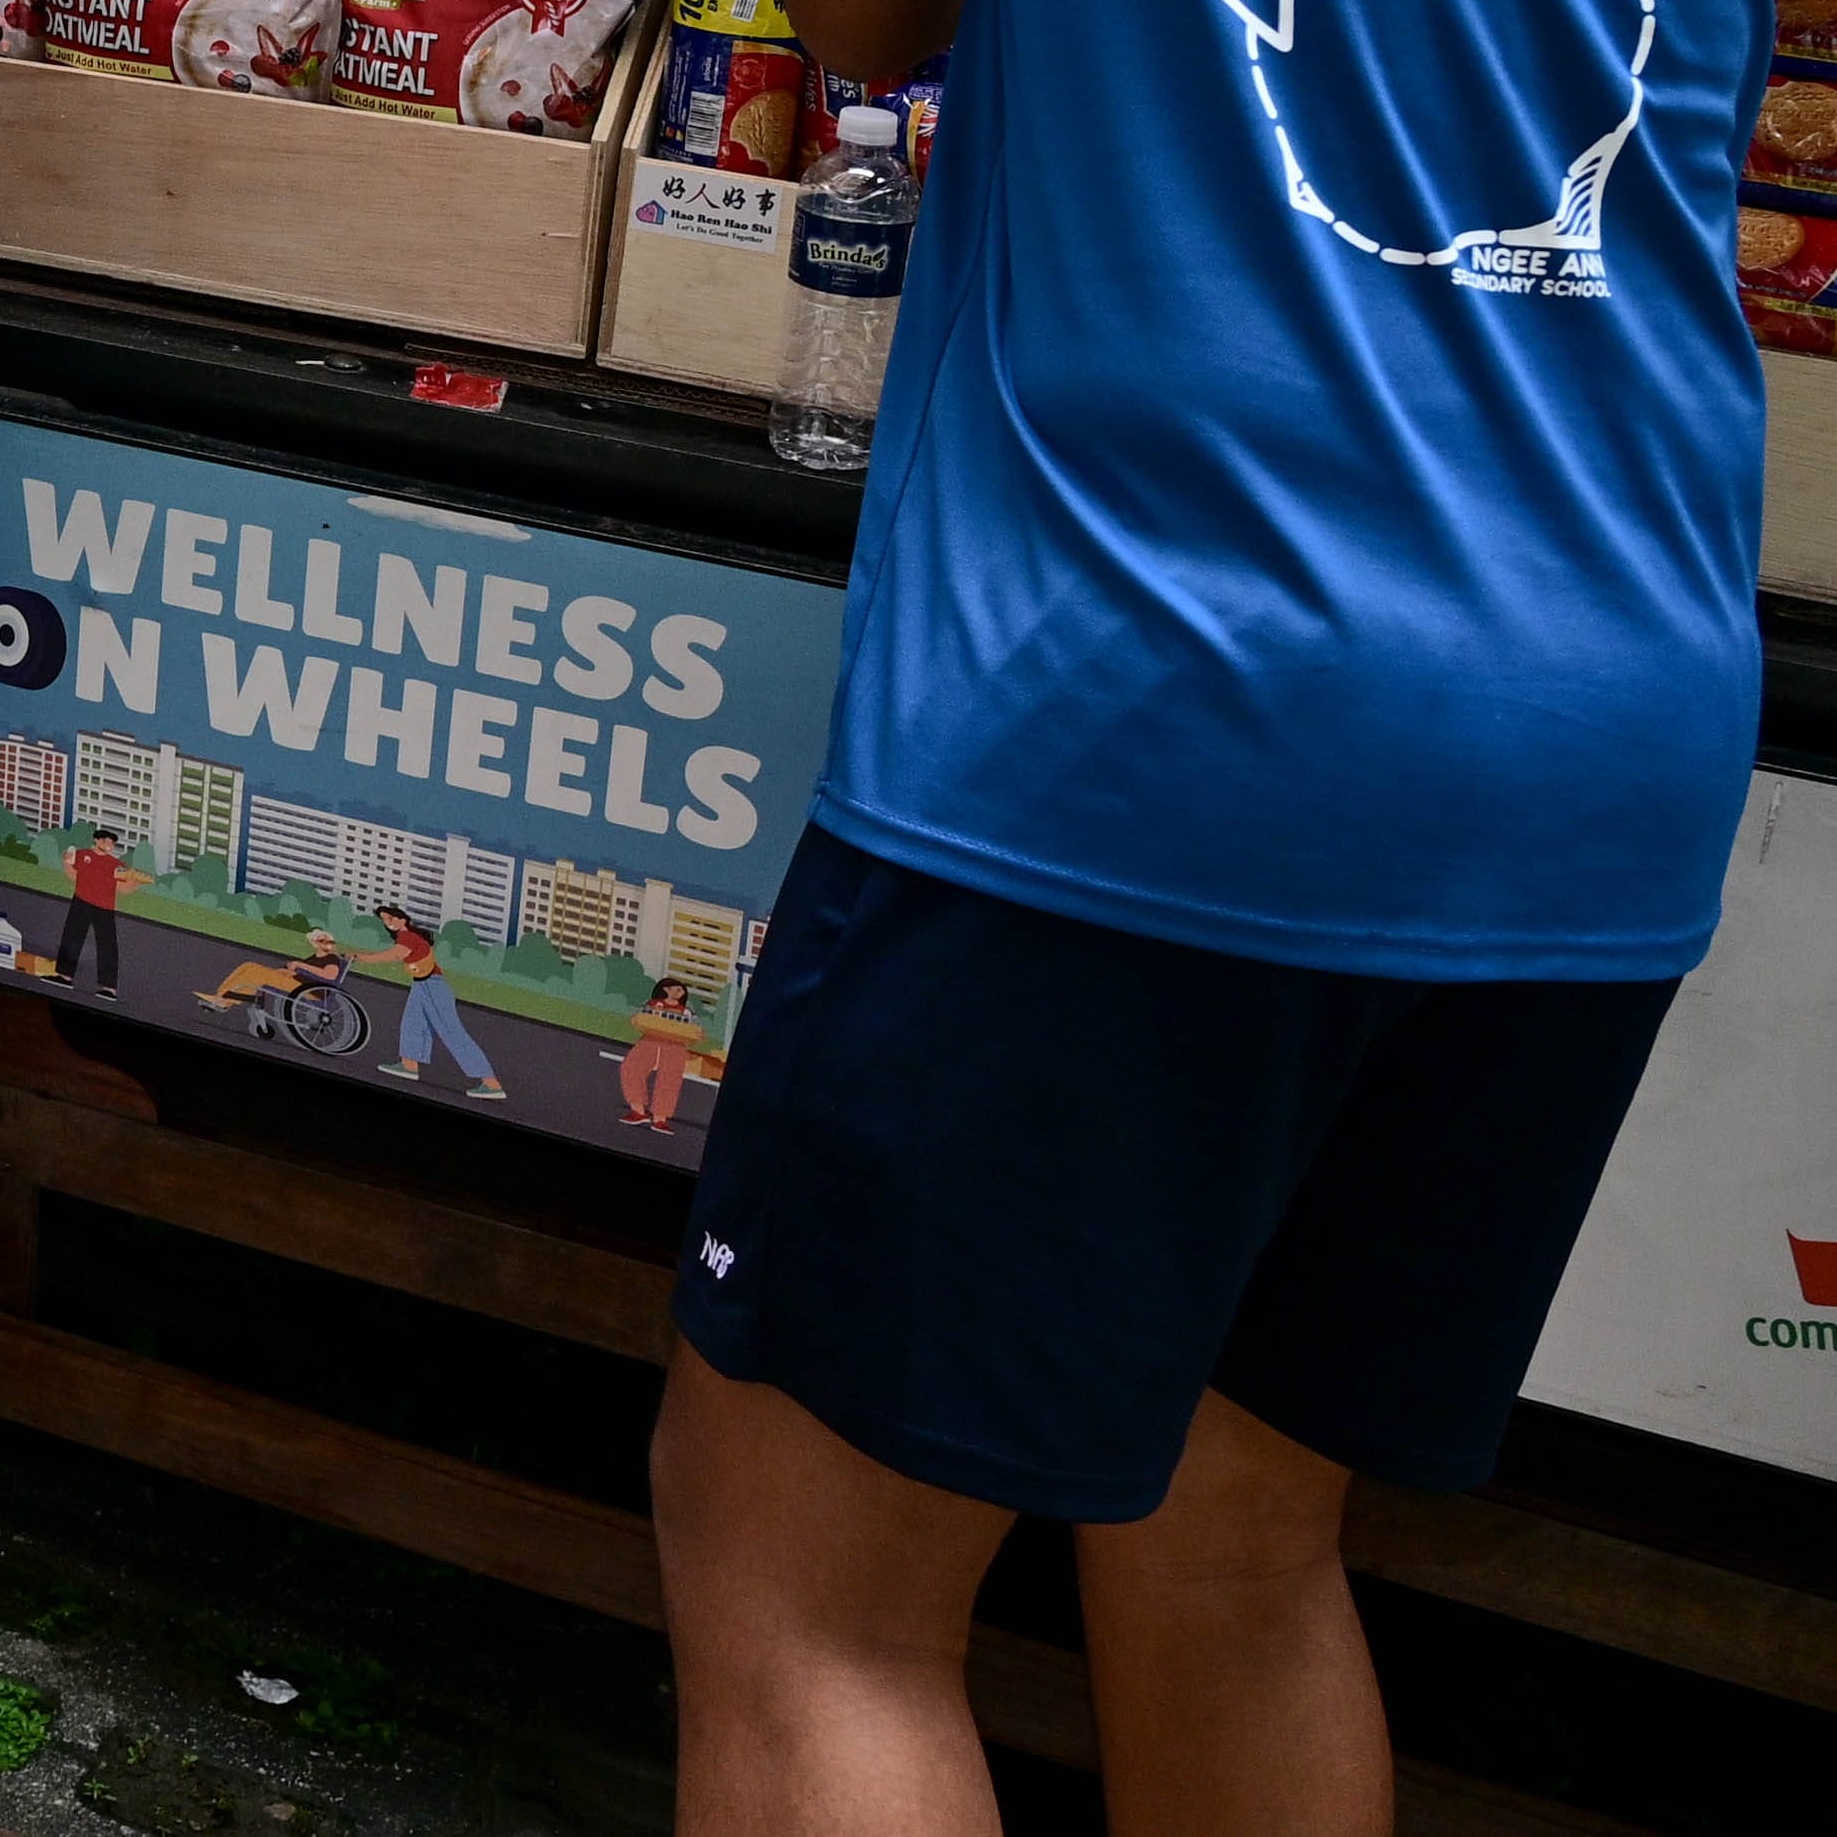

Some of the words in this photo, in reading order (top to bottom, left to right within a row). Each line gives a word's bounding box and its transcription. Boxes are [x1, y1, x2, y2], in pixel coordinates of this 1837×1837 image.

[55, 48, 74, 65] Just
[75, 54, 94, 68] Add
[96, 58, 117, 72] Hot
[119, 61, 153, 76] Water
[334, 49, 435, 96] ATMEAL
[354, 95, 376, 109] Add
[378, 99, 399, 115] Hot
[401, 103, 436, 121] Water
[662, 176, 777, 217] 好人好事
[670, 209, 695, 222] Hao
[697, 214, 721, 227] Ren
[724, 218, 749, 231] Hao
[751, 223, 773, 235] Shi
[697, 226, 707, 235] Do
[709, 228, 729, 238] Good
[732, 232, 764, 244] Together
[1471, 246, 1552, 276] NGEE
[21, 477, 729, 721] WELLNESS
[202, 631, 764, 851] WHEELS
